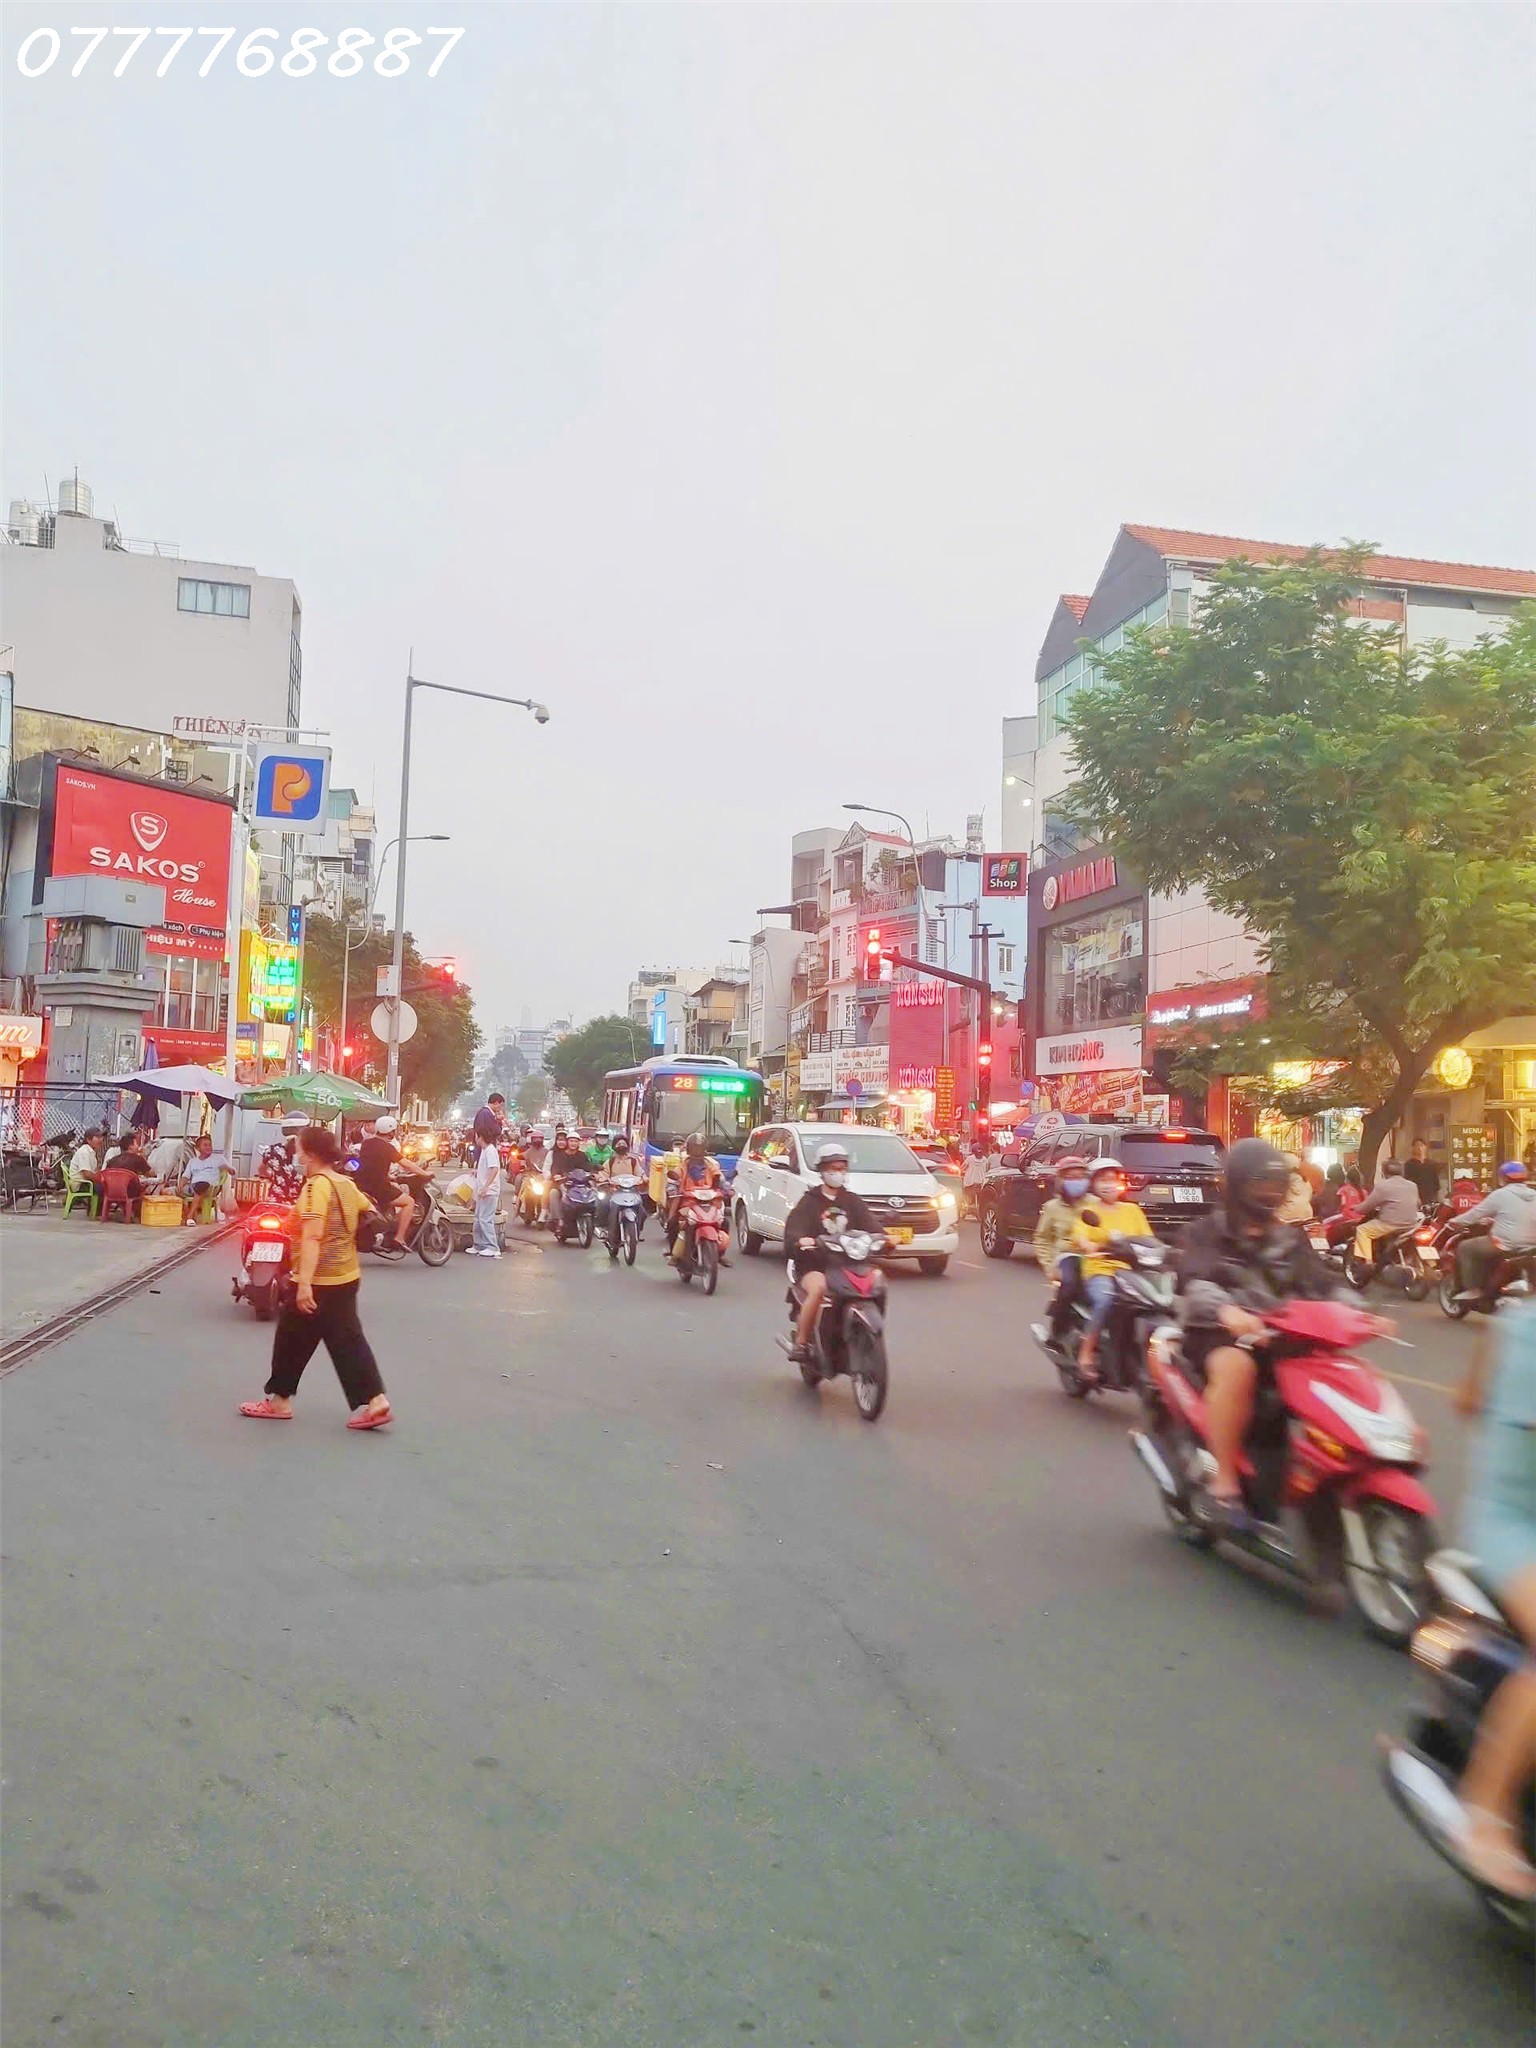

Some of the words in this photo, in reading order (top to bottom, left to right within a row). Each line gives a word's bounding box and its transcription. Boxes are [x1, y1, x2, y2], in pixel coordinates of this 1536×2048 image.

[173, 716, 230, 734] THIÊN
[65, 777, 96, 790] SAKOS.VN
[89, 846, 200, 883] SAKOS
[990, 858, 1019, 878] FPT
[989, 878, 1018, 889] Shop
[172, 888, 217, 907] House
[673, 1077, 692, 1088] 28
